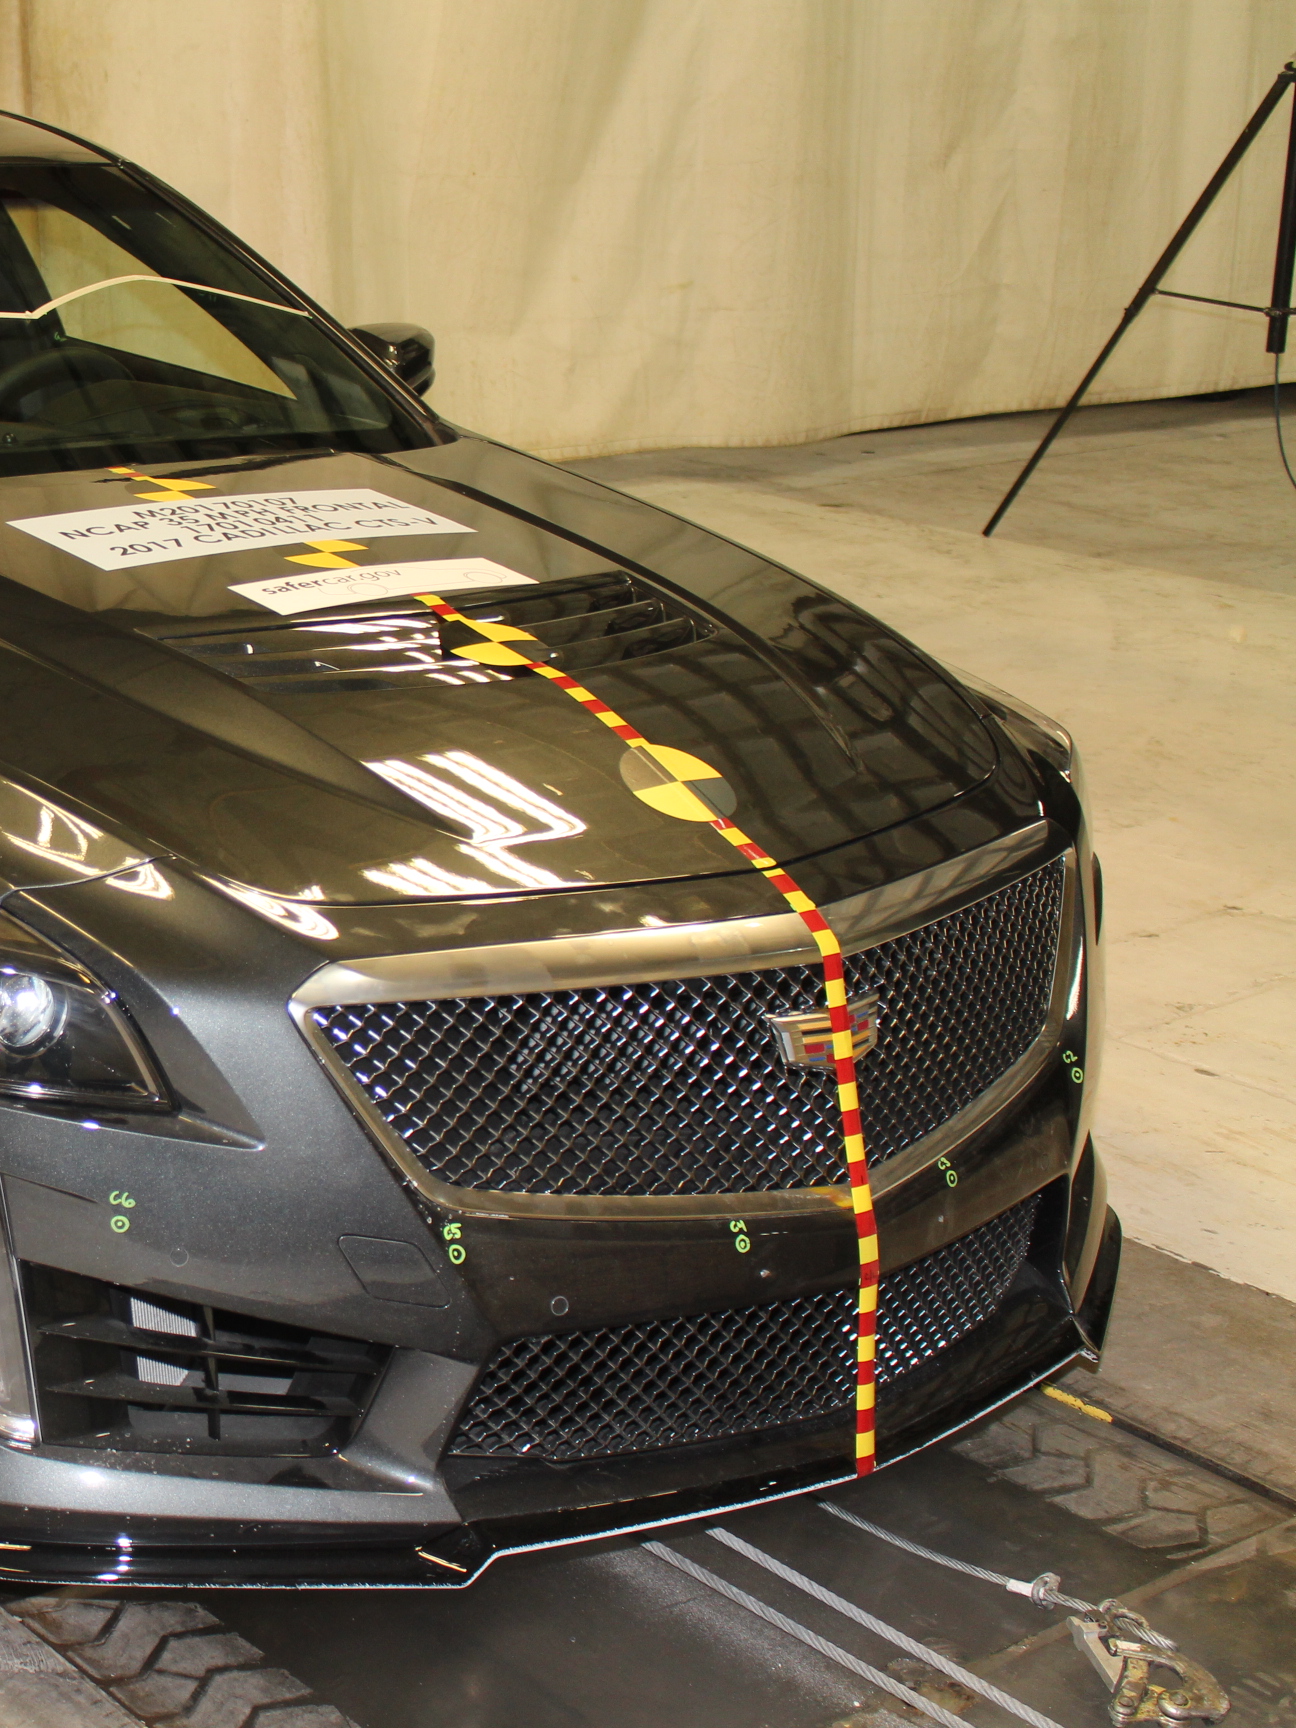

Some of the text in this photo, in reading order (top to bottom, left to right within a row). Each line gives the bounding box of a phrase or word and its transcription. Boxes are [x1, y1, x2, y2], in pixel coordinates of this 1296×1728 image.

[58, 501, 412, 540] NCAP 35 MPH FRONTAL
[131, 497, 298, 520] M20170107
[109, 517, 439, 557] 2017 CADILLAC CTS-V
[180, 514, 326, 535] 17010411
[261, 568, 402, 596] safercar.gov
[109, 1190, 136, 1209] C6
